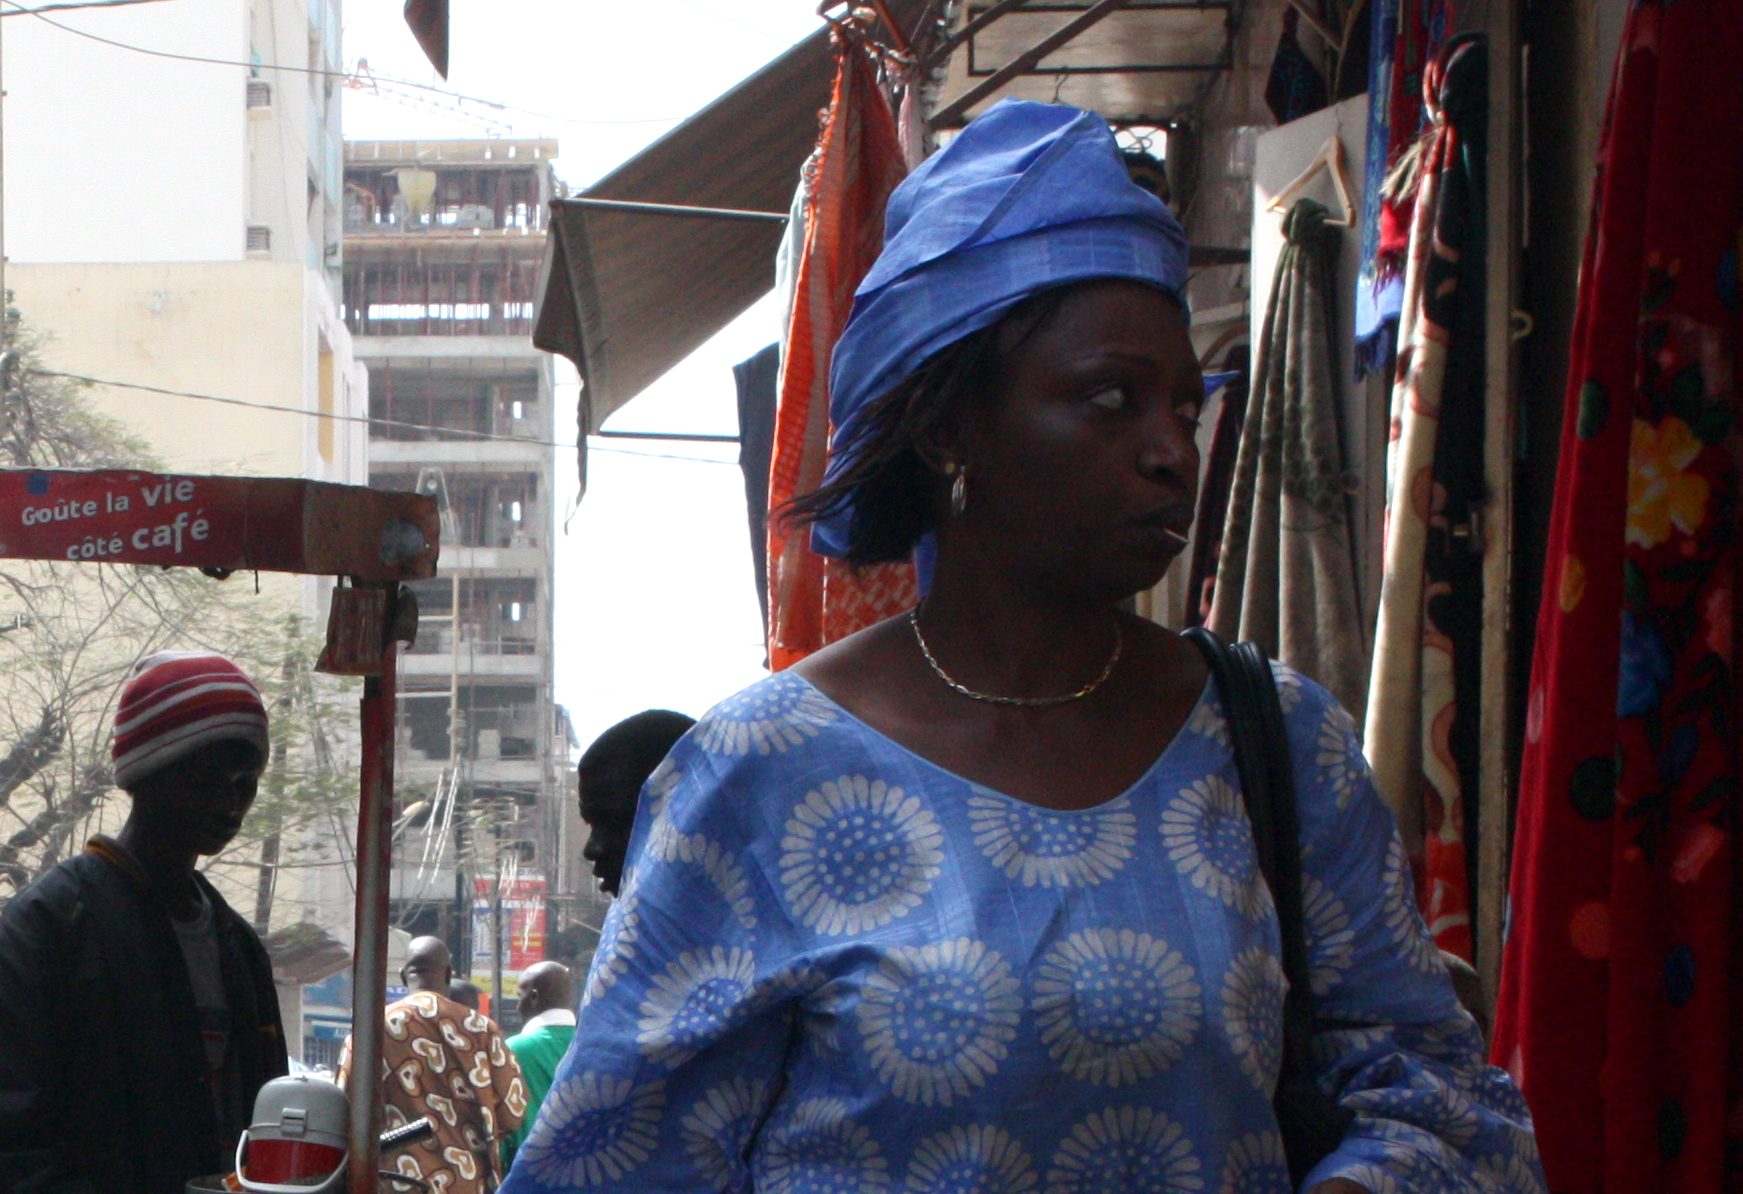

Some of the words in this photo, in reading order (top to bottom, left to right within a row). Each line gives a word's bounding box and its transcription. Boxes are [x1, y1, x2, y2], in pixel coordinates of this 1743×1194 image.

[21, 499, 98, 527] Goûte
[106, 491, 130, 513] la
[140, 477, 195, 507] vie
[66, 532, 124, 560] côté
[131, 508, 210, 553] café
